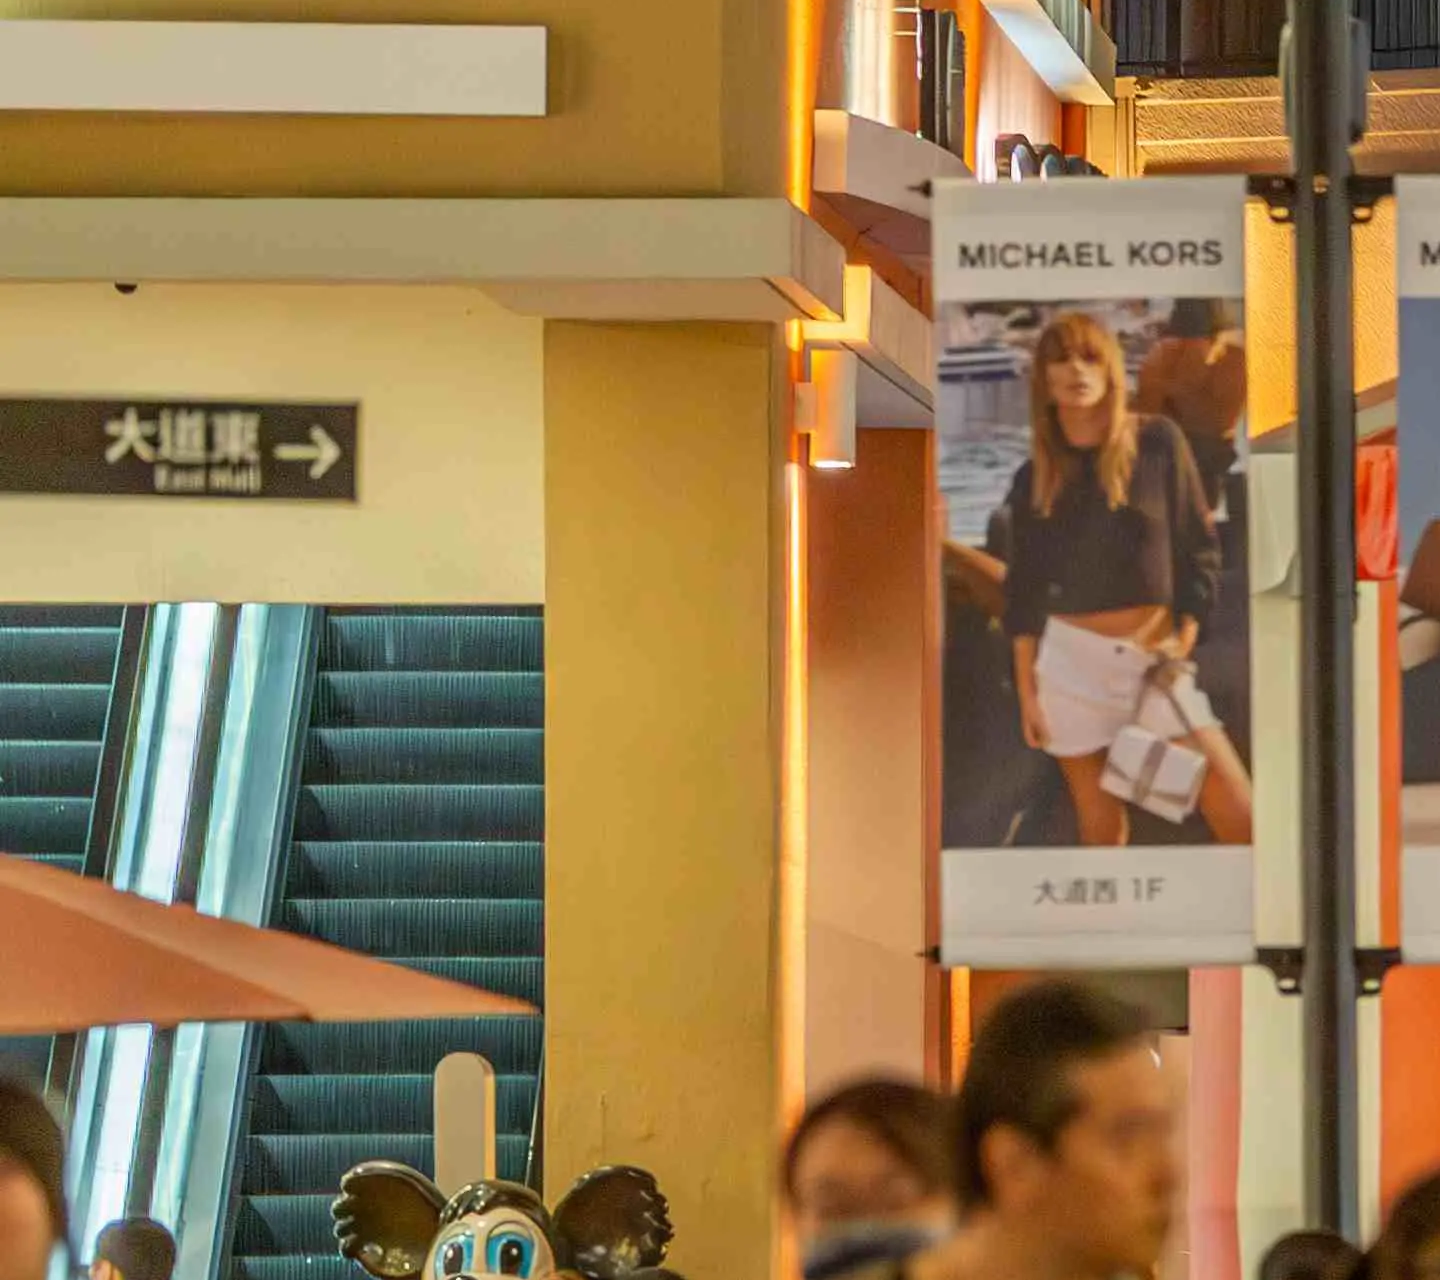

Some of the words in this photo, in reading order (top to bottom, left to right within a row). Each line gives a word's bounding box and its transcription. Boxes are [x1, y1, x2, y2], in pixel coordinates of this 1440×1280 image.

[957, 241, 1114, 269] MICHAEL
[1127, 239, 1223, 267] KORS
[104, 407, 260, 463] 大道東
[1032, 876, 1119, 906] 大道西
[1131, 876, 1167, 903] 1F
